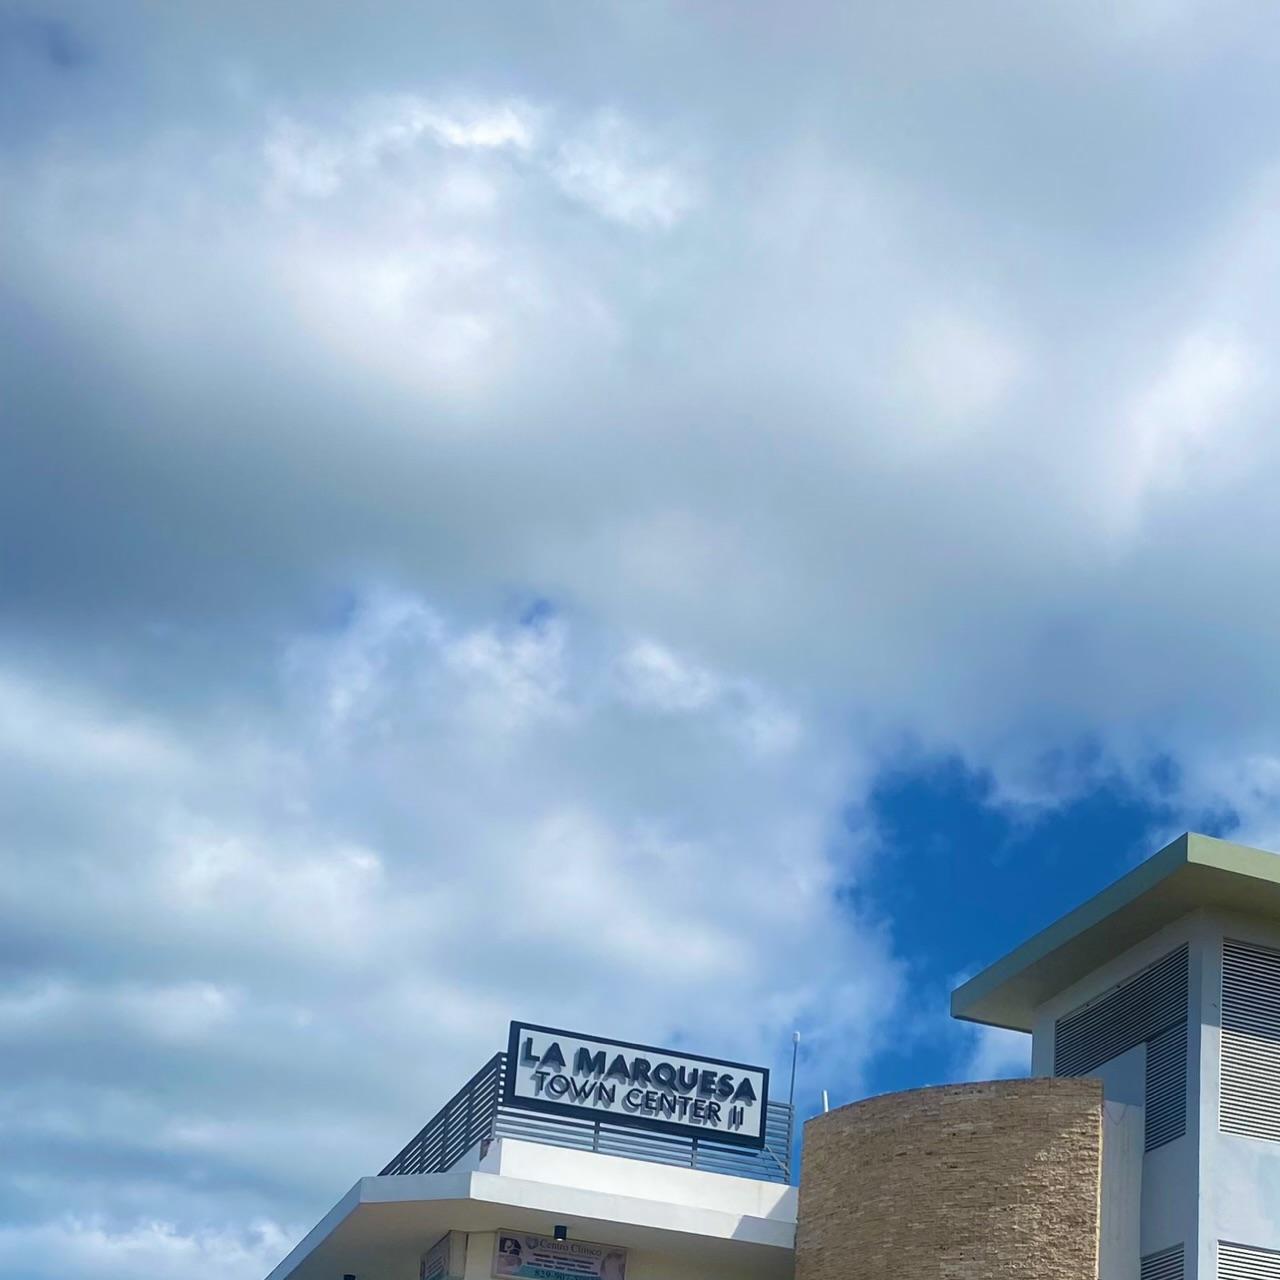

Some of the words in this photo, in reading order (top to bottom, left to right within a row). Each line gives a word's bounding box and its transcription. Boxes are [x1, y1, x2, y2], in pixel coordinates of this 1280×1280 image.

[523, 1037, 566, 1068] LA
[576, 1046, 758, 1104] MARQUESA
[533, 1070, 616, 1105] TOWN
[624, 1087, 722, 1125] CENTER
[731, 1104, 745, 1128] II
